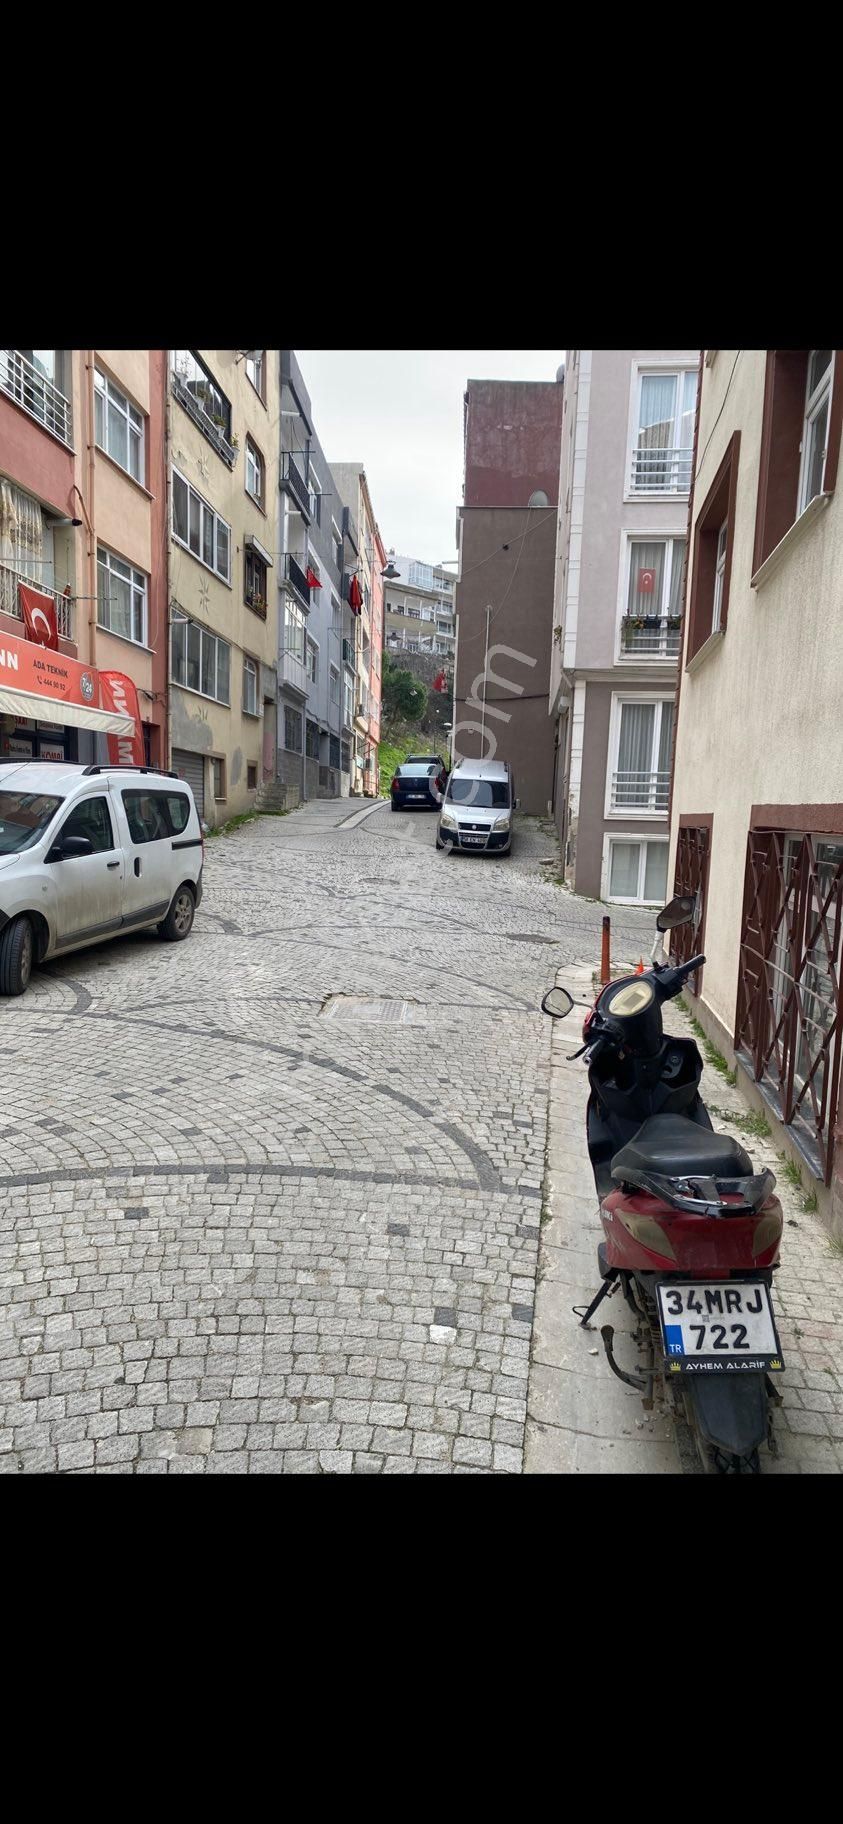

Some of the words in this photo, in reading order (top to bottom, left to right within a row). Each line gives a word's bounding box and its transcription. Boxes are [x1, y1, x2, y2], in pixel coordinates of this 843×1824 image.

[33, 659, 46, 672] ADA
[689, 1323, 751, 1350] 722
[669, 1344, 682, 1353] TR
[685, 1362, 724, 1370] AYHEM
